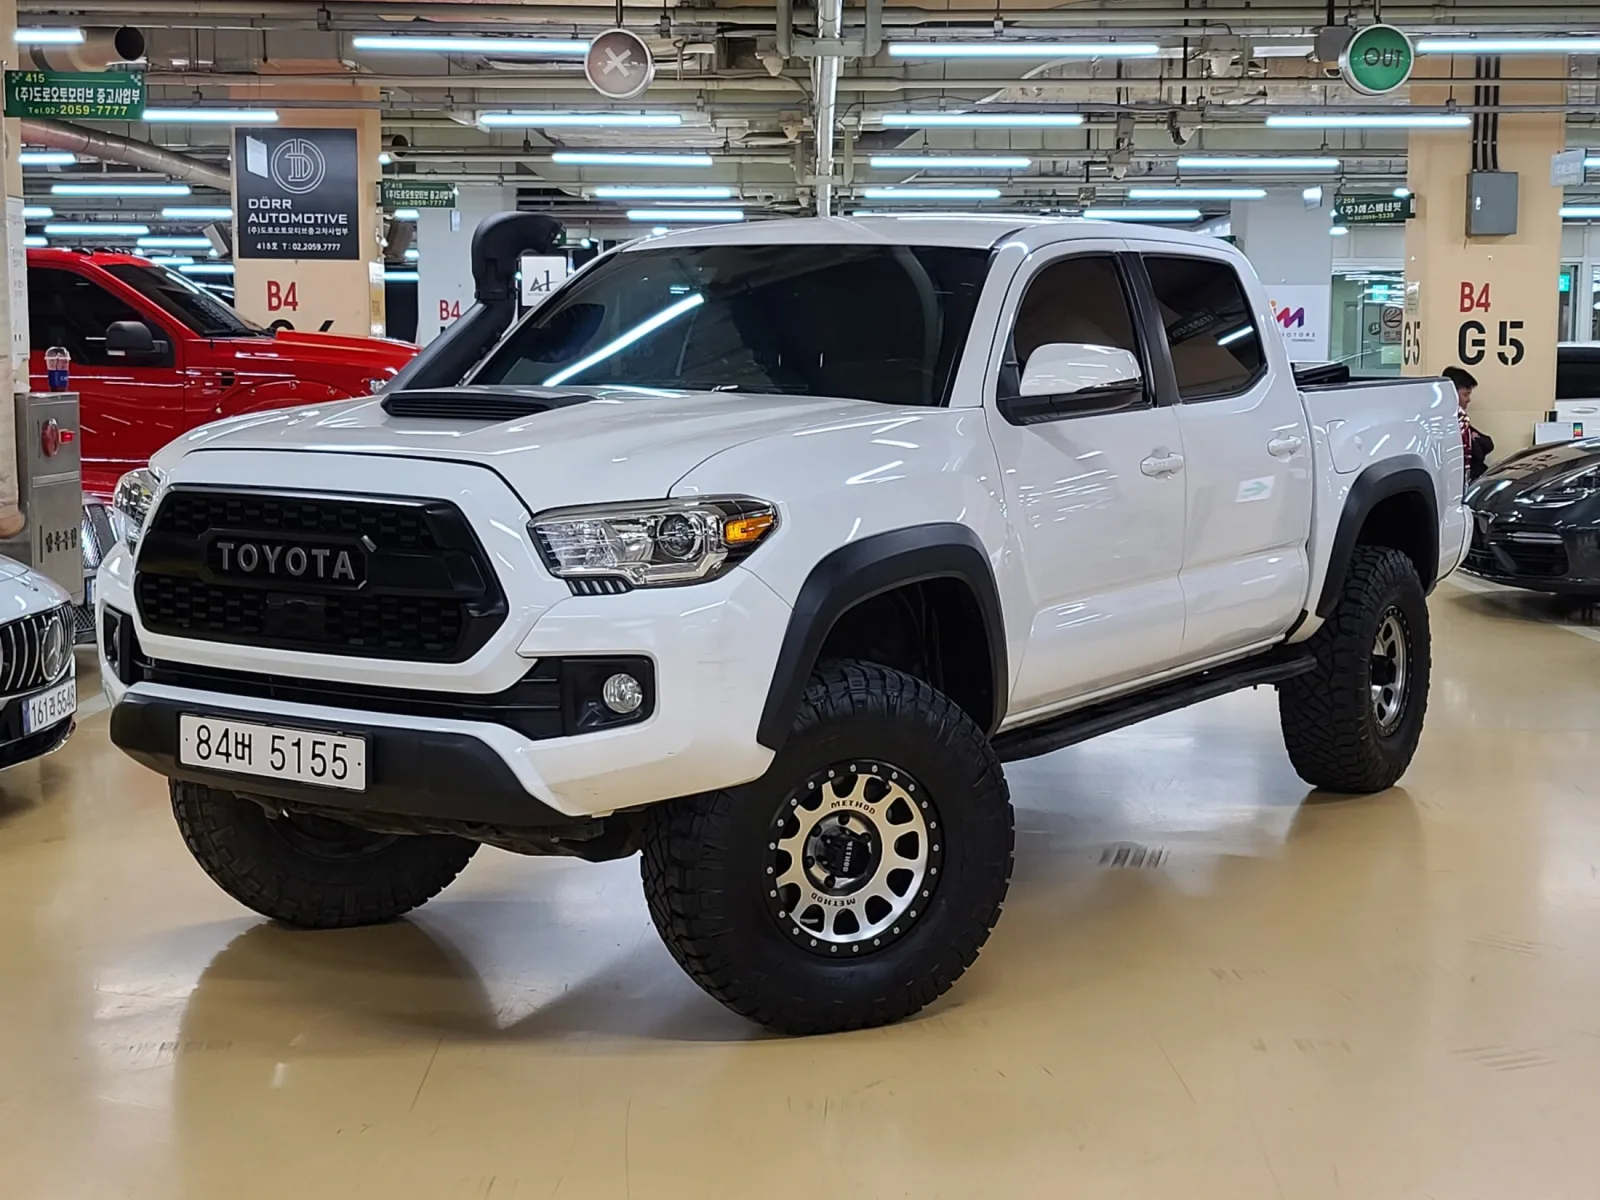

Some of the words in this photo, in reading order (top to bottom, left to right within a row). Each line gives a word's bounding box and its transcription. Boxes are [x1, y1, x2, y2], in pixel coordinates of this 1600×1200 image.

[1364, 47, 1403, 69] OUT
[25, 73, 45, 83] 415
[97, 88, 140, 104] 중고사업부
[247, 196, 293, 209] DÖRR
[247, 212, 349, 225] AUTOMOTIVE
[267, 280, 299, 312] B4
[1459, 281, 1491, 313] B4
[439, 300, 461, 321] B4
[216, 541, 355, 580] TOYOTA
[196, 724, 252, 766] 84버
[270, 734, 348, 780] 5155
[830, 800, 876, 815] METHOD
[842, 840, 853, 872] METHOD
[811, 892, 856, 907] METHOD
